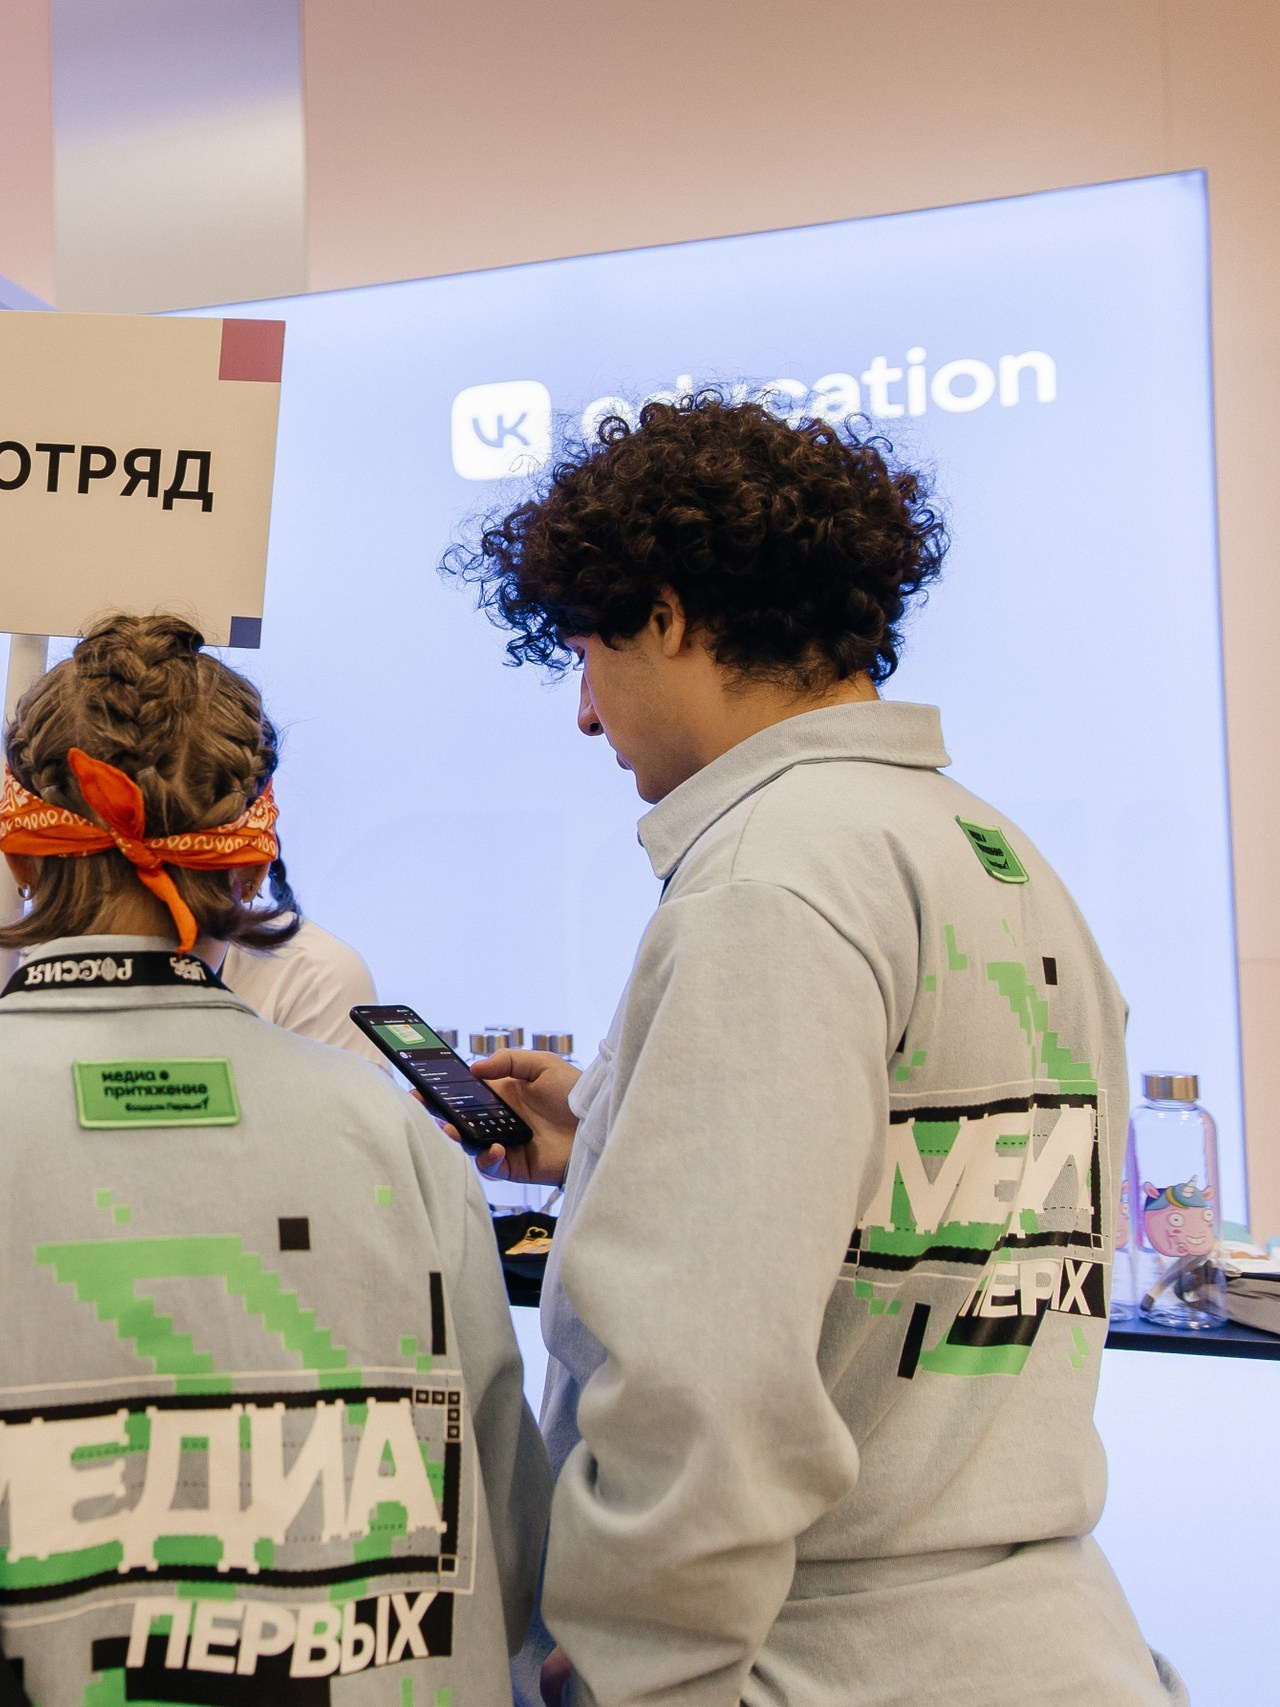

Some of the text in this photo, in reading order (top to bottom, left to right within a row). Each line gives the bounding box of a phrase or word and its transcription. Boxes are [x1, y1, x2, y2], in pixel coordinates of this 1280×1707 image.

[101, 1069, 156, 1083] медиа
[103, 1083, 209, 1099] притяжение
[125, 1592, 439, 1679] ПЕРВЫХ
